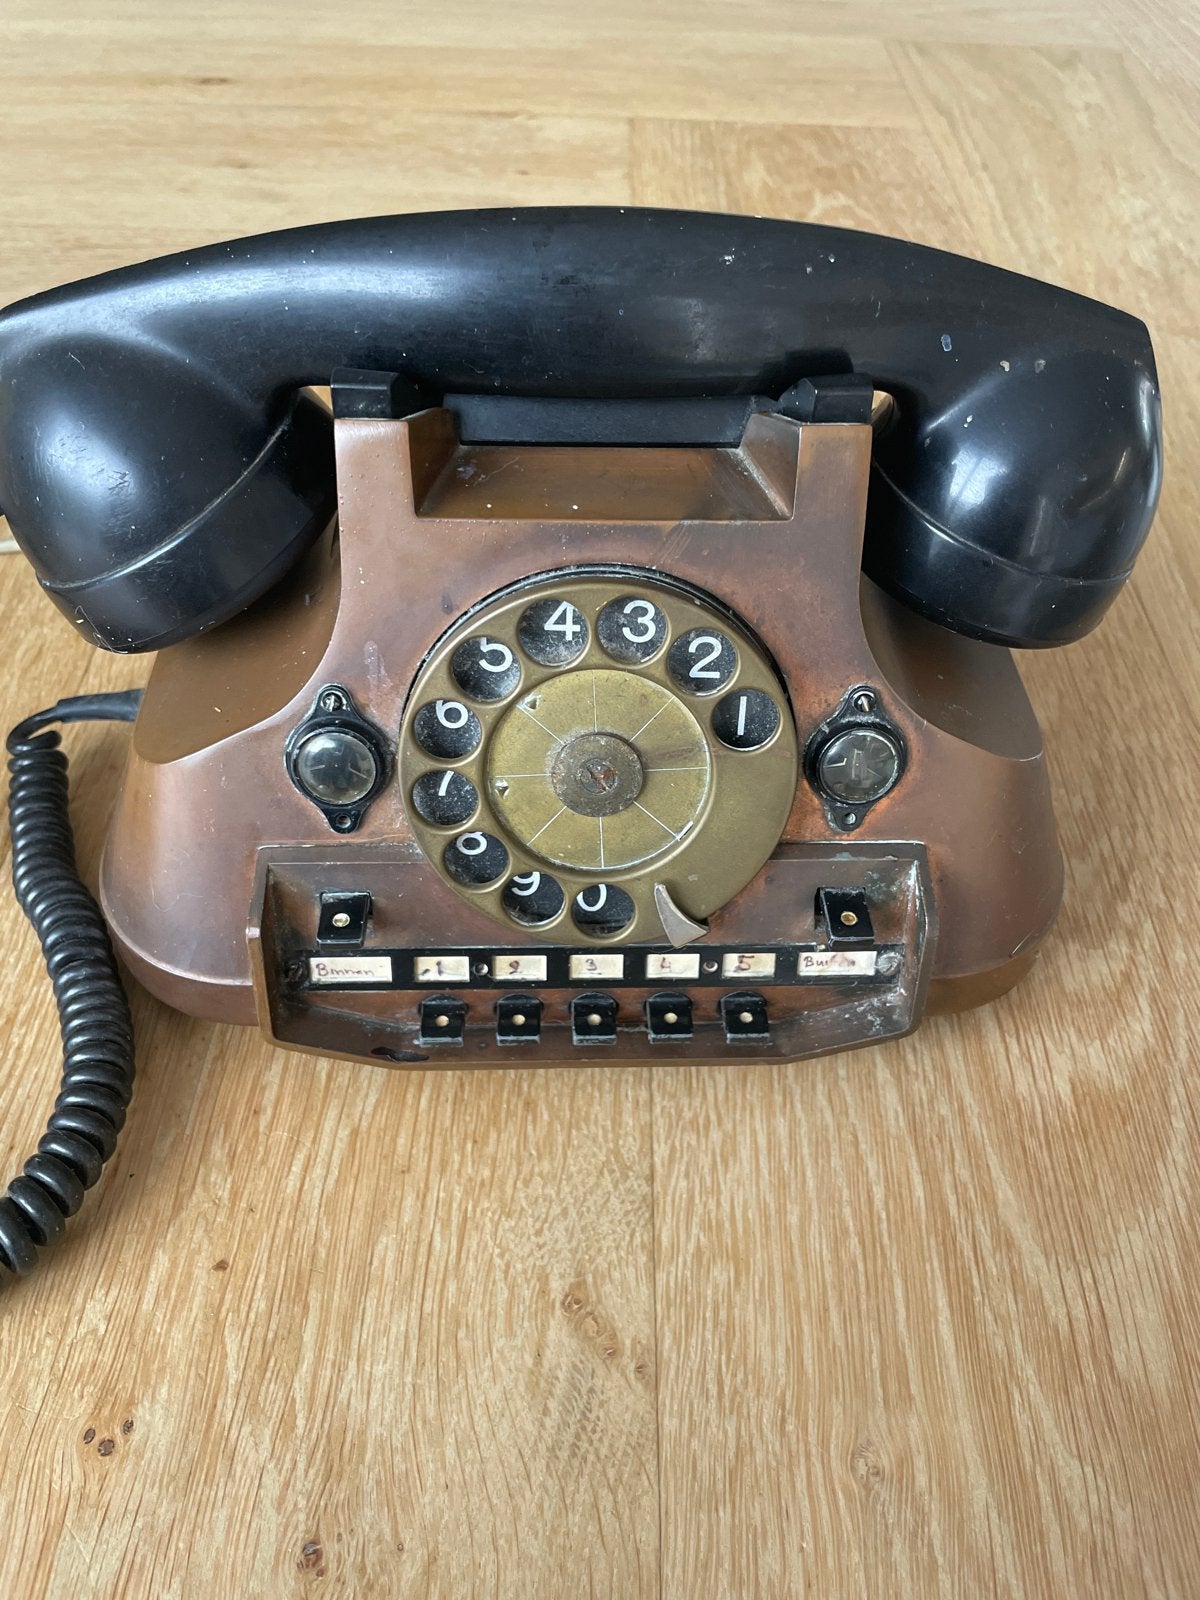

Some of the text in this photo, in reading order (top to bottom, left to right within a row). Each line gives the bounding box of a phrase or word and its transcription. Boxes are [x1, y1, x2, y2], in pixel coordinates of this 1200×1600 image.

[544, 600, 581, 641] 4
[621, 600, 657, 644] 3
[478, 636, 514, 673] 5
[687, 636, 723, 679] 2
[435, 699, 469, 729] 6
[736, 695, 748, 736] 1
[437, 770, 455, 797] 7
[510, 871, 541, 897] 9
[508, 960, 524, 976] 2
[585, 958, 599, 972] 3
[734, 954, 756, 973] 5
